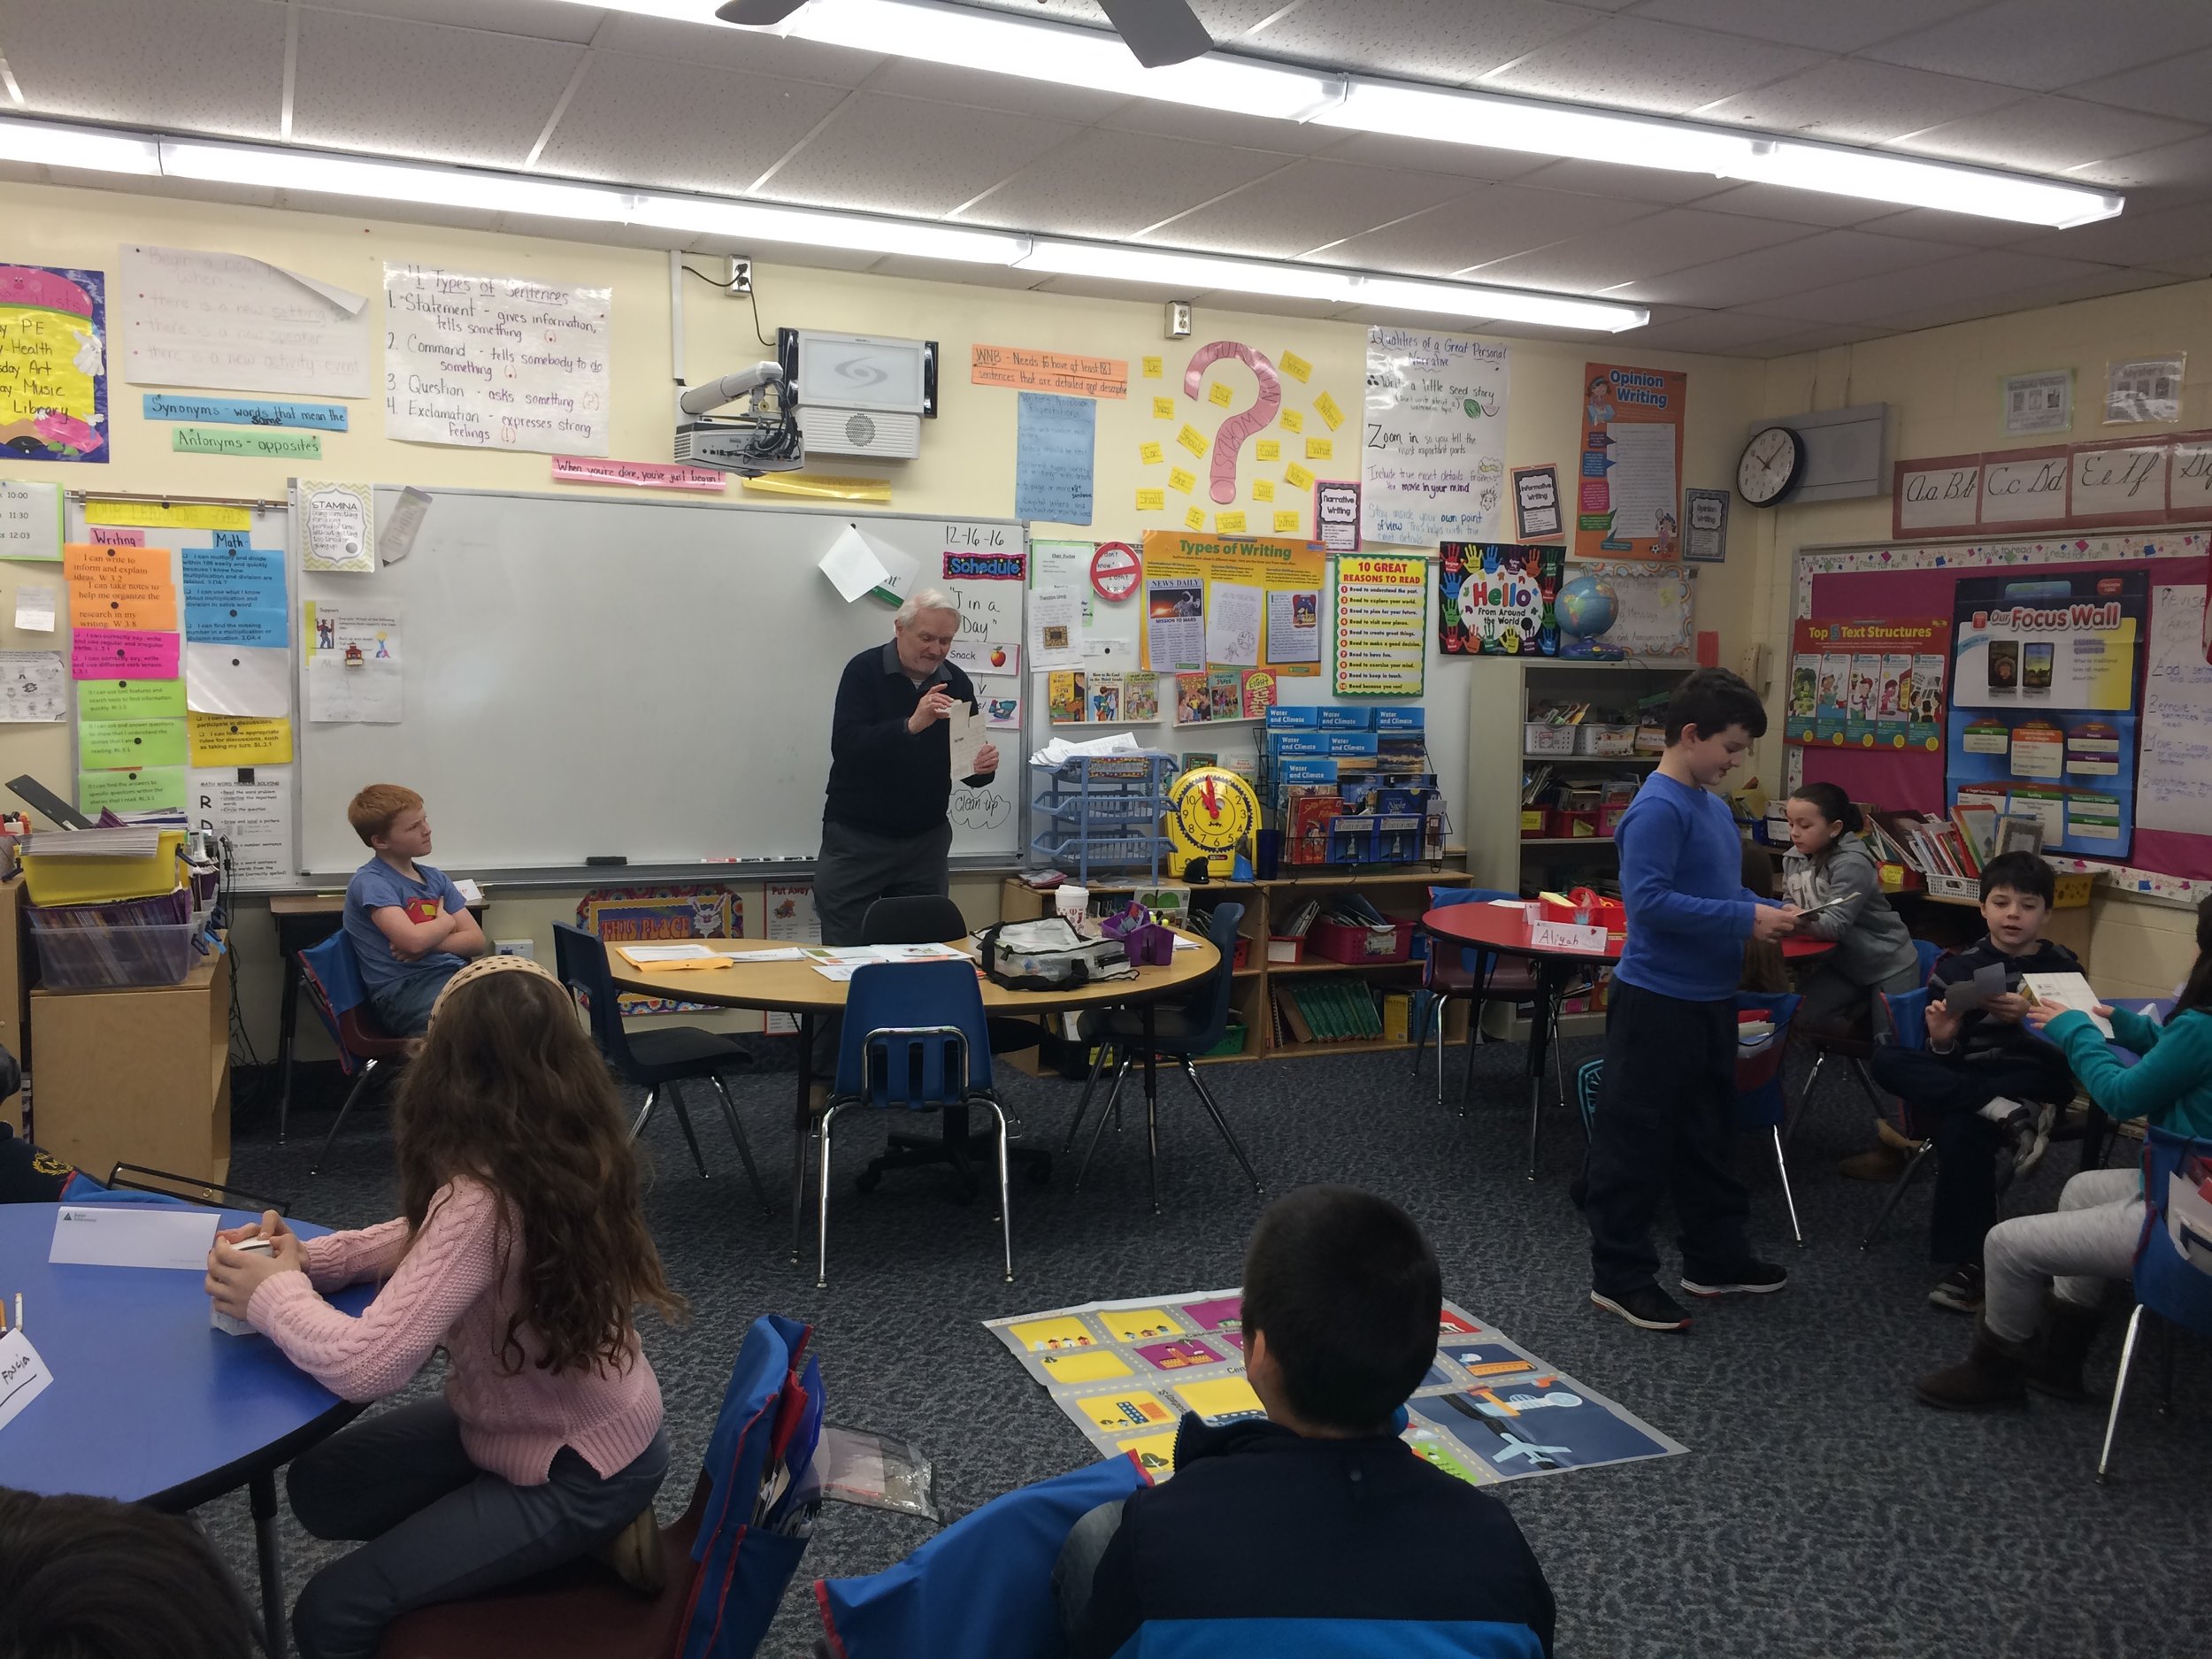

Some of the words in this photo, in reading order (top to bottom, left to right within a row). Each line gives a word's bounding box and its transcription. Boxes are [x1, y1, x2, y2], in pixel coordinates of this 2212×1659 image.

[433, 270, 471, 293] Types
[480, 282, 495, 293] of
[388, 290, 396, 309] 1.
[403, 292, 476, 317] Statement
[497, 312, 526, 325] gives
[533, 314, 596, 334] information,
[22, 320, 44, 335] PE
[437, 316, 462, 331] tells
[468, 323, 522, 342] something
[12, 342, 53, 356] Health
[407, 334, 465, 356] Command
[491, 347, 515, 362] tells
[521, 353, 572, 373] somebody
[578, 357, 587, 368] to
[590, 357, 603, 372] do
[1423, 339, 1431, 349] of
[1445, 339, 1468, 354] Great
[1473, 342, 1507, 358] Personal
[29, 362, 51, 375] Art
[441, 359, 492, 381] something
[976, 348, 1002, 362] WNB
[1013, 352, 1038, 366] Needs
[1042, 356, 1048, 367] to
[1052, 357, 1068, 369] have
[1070, 361, 1078, 373] at
[1082, 361, 1099, 373] least
[979, 371, 1015, 382] sentences
[1020, 372, 1035, 384] that
[1056, 376, 1083, 389] detailed
[1610, 370, 1663, 388] Opinion
[409, 375, 464, 396] Question
[488, 390, 514, 403] asks
[526, 392, 574, 412] something
[1423, 380, 1443, 391] little
[1450, 384, 1468, 395] seed
[1473, 384, 1494, 404] story
[1617, 388, 1667, 408] Writing
[14, 398, 69, 425] Library
[152, 397, 220, 415] Synonyms
[234, 407, 269, 418] words
[274, 406, 296, 421] that
[302, 411, 326, 421] mean
[329, 409, 345, 422] the
[409, 400, 479, 423] Exclamation
[502, 415, 552, 428] expresses
[558, 419, 591, 438] strong
[1321, 402, 1338, 426] Where
[178, 431, 242, 449] Antonyms
[257, 436, 319, 453] opposites
[1368, 424, 1402, 449] Zoom
[1409, 433, 1418, 443] in
[1435, 436, 1448, 448] you
[556, 459, 583, 472] When
[618, 465, 640, 480] done,
[669, 470, 687, 483] just
[691, 471, 721, 484] begun!
[1988, 467, 2020, 495] Cc
[1423, 481, 1429, 490] in
[1431, 484, 1448, 499] your
[1450, 483, 1470, 492] mind
[1521, 483, 1551, 492] Informative
[312, 501, 357, 510] STAMINA
[1527, 493, 1548, 502] Writing
[1327, 507, 1350, 516] Writing
[1461, 511, 1482, 524] point
[1378, 520, 1386, 531] of
[1387, 521, 1402, 531] view
[94, 530, 136, 547] Writing
[217, 533, 243, 549] Math
[946, 525, 1004, 547] 12-16-16
[1180, 540, 1218, 554] Types
[1223, 542, 1237, 554] of
[1240, 543, 1292, 560] Writing
[951, 558, 1020, 574] Schedule
[1358, 562, 1371, 572] 10
[1374, 563, 1407, 572] GREAT
[1473, 582, 1531, 607] Hello
[969, 600, 980, 610] in
[988, 602, 1000, 612] a
[1479, 607, 1496, 617] From
[1499, 607, 1525, 618] Around
[1484, 617, 1495, 626] the
[1498, 617, 1520, 626] World
[1991, 610, 2010, 625] Our
[2012, 608, 2067, 629] Focus
[2071, 603, 2119, 628] Wall
[1809, 627, 1828, 640] Top
[1830, 624, 1839, 640] 5
[1841, 626, 1866, 638] Text
[1868, 626, 1932, 638] Structures
[950, 650, 975, 660] Snack
[956, 795, 980, 811] Clean
[985, 800, 998, 817] up
[772, 887, 786, 895] Put
[787, 887, 810, 896] Away
[602, 918, 637, 941] THIS
[642, 918, 689, 941] PLACE
[1540, 930, 1578, 946] Aliyah
